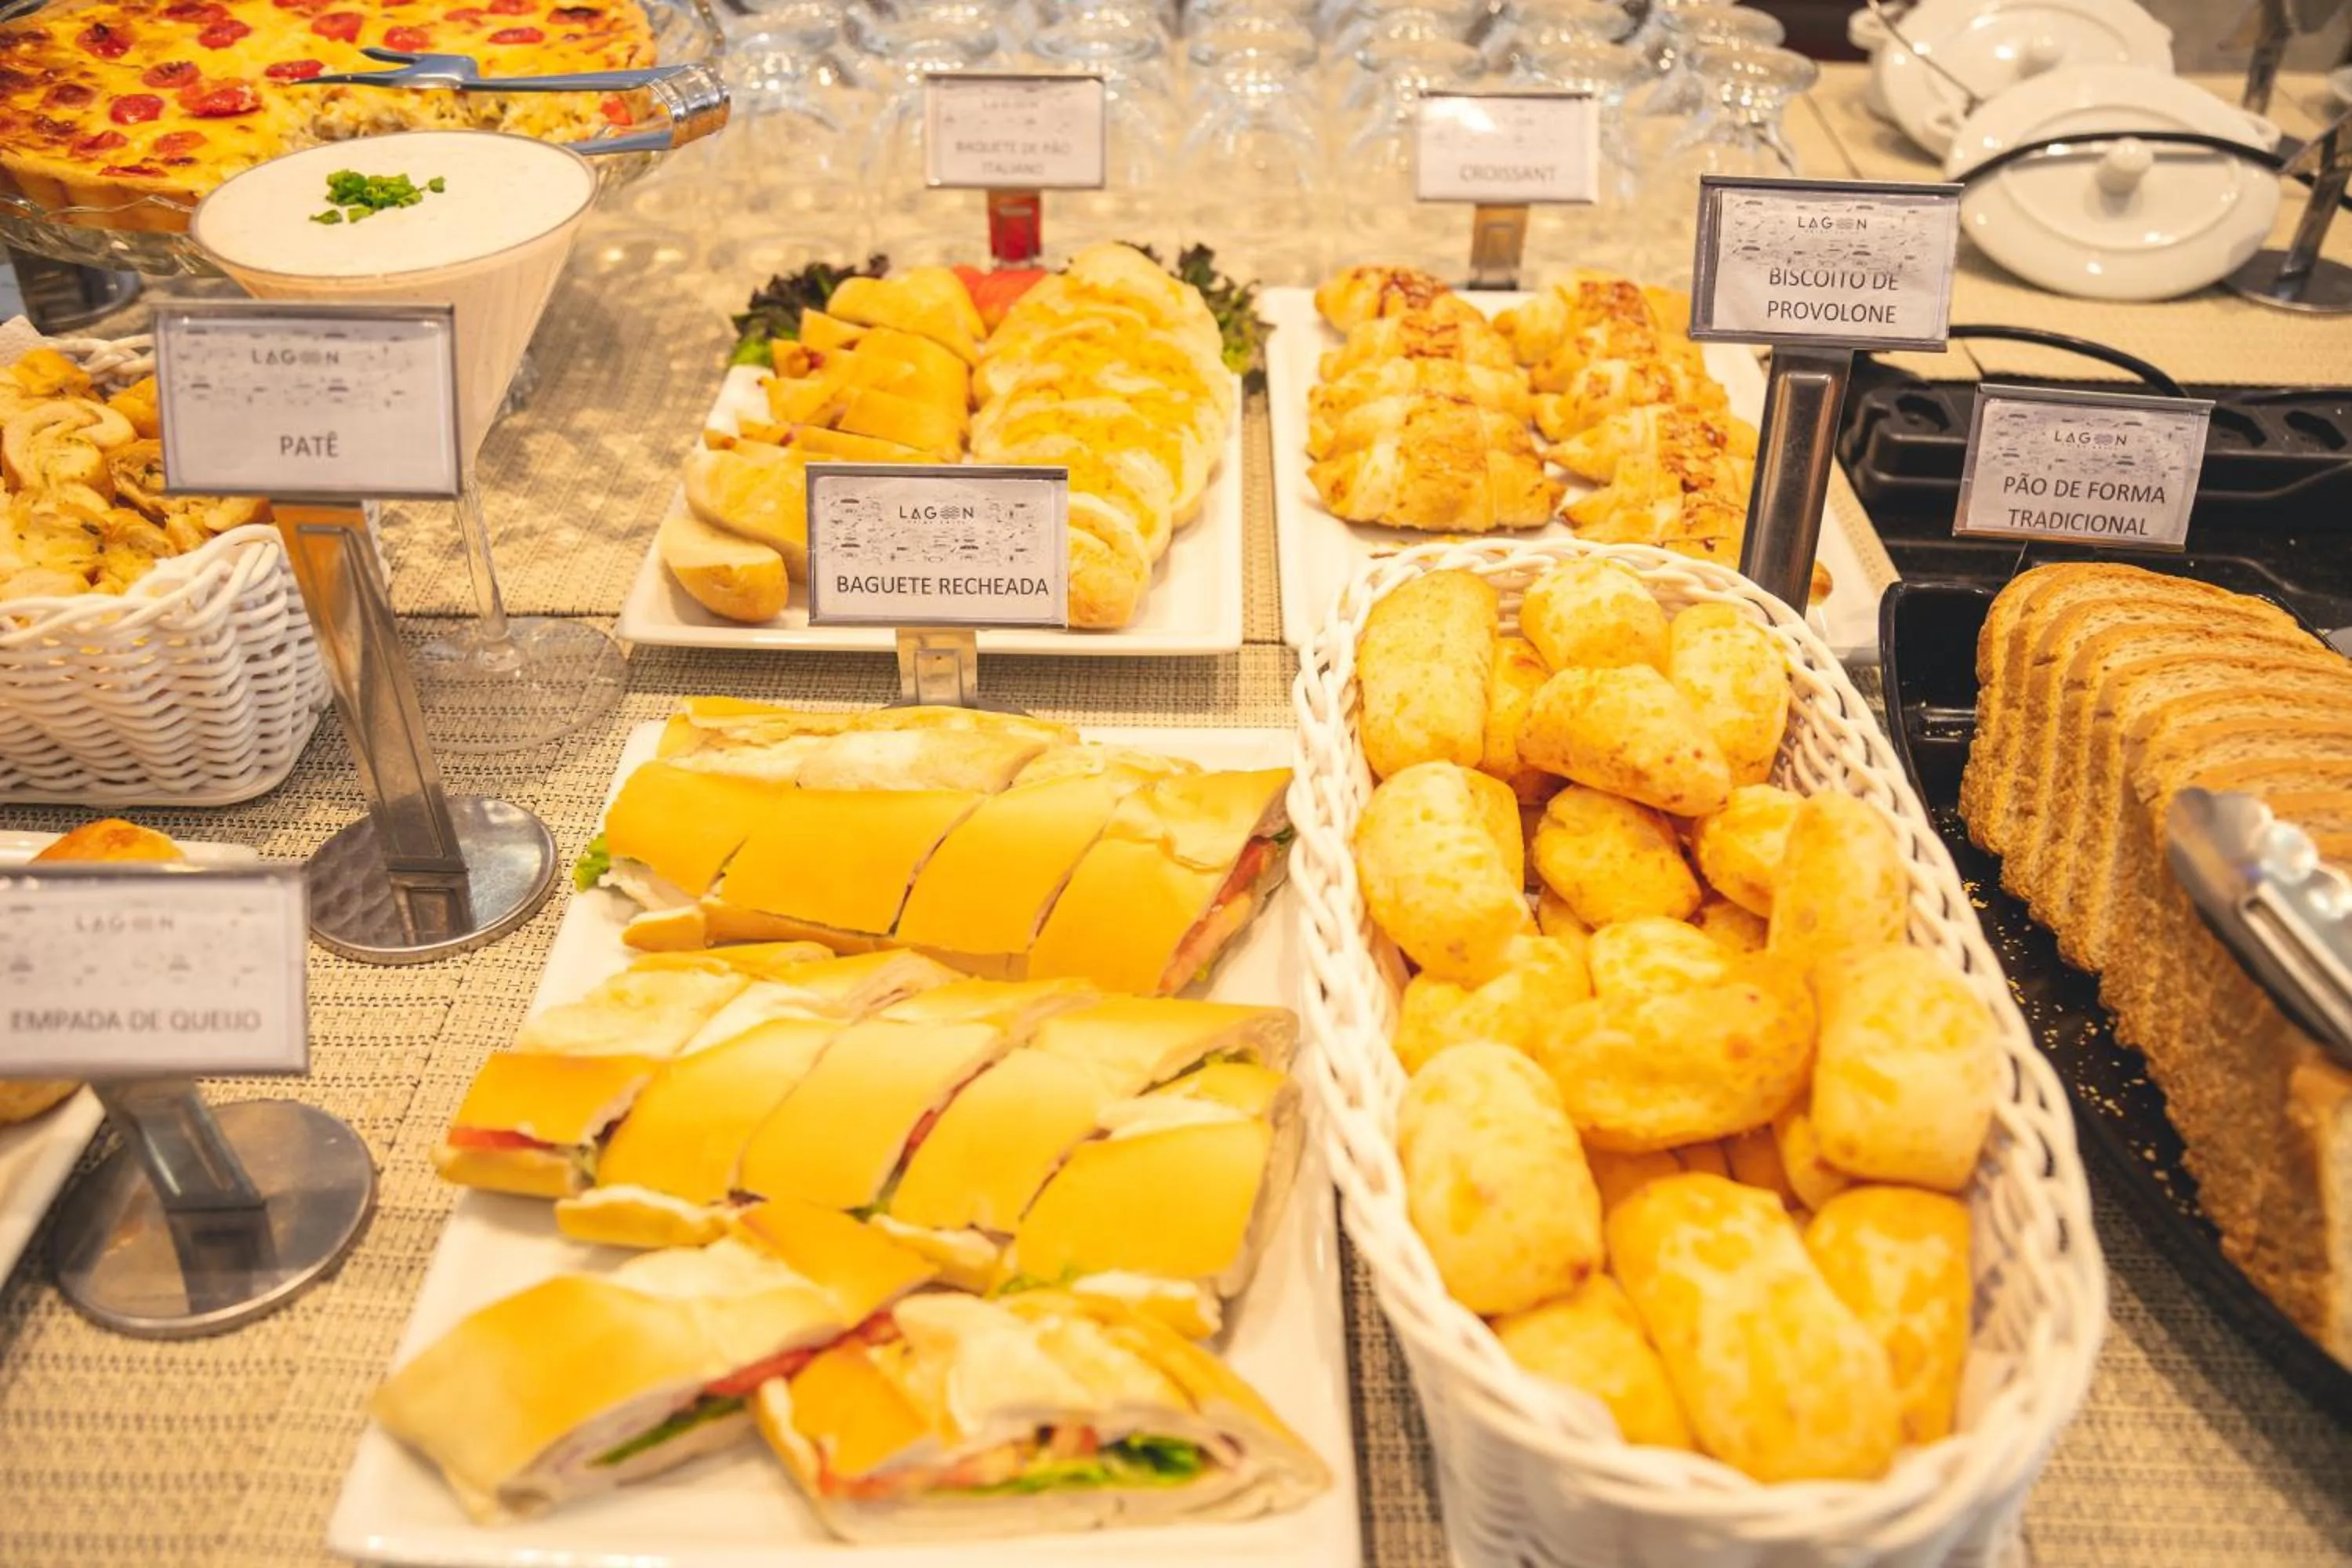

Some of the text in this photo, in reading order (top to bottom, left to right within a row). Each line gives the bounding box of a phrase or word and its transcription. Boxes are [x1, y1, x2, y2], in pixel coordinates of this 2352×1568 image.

[1460, 164, 1557, 181] CROISSANT
[1769, 267, 1900, 291] BISCOITO DE
[1766, 300, 1897, 324] PROVOLONE
[280, 430, 339, 458] PATÊ
[2003, 473, 2166, 504] PÃO DE FORMA
[2008, 508, 2150, 536] TRADICIONAL
[837, 575, 1050, 596] BAGUETE RECHEADA
[9, 1008, 263, 1033] EMPADA DE QUEIJO
